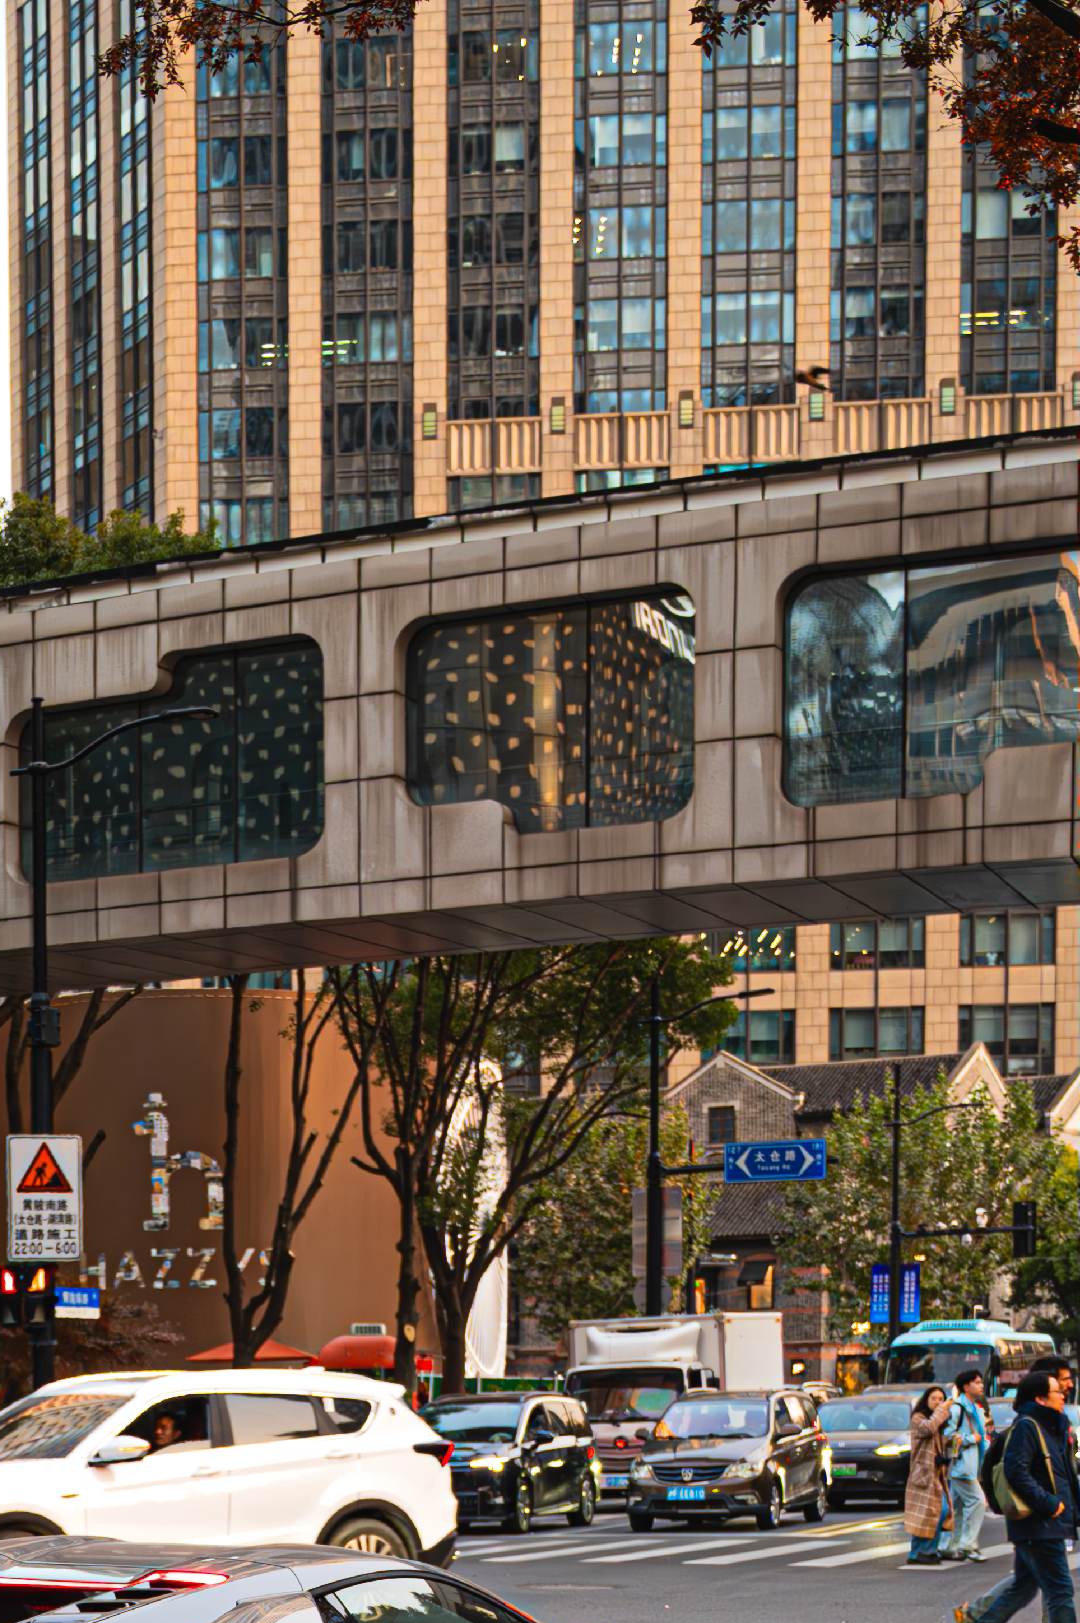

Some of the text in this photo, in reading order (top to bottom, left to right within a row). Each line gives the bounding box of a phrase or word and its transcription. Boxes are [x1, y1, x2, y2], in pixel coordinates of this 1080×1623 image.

[754, 1150, 796, 1163] 太仓路
[15, 1229, 76, 1240] 道路施工
